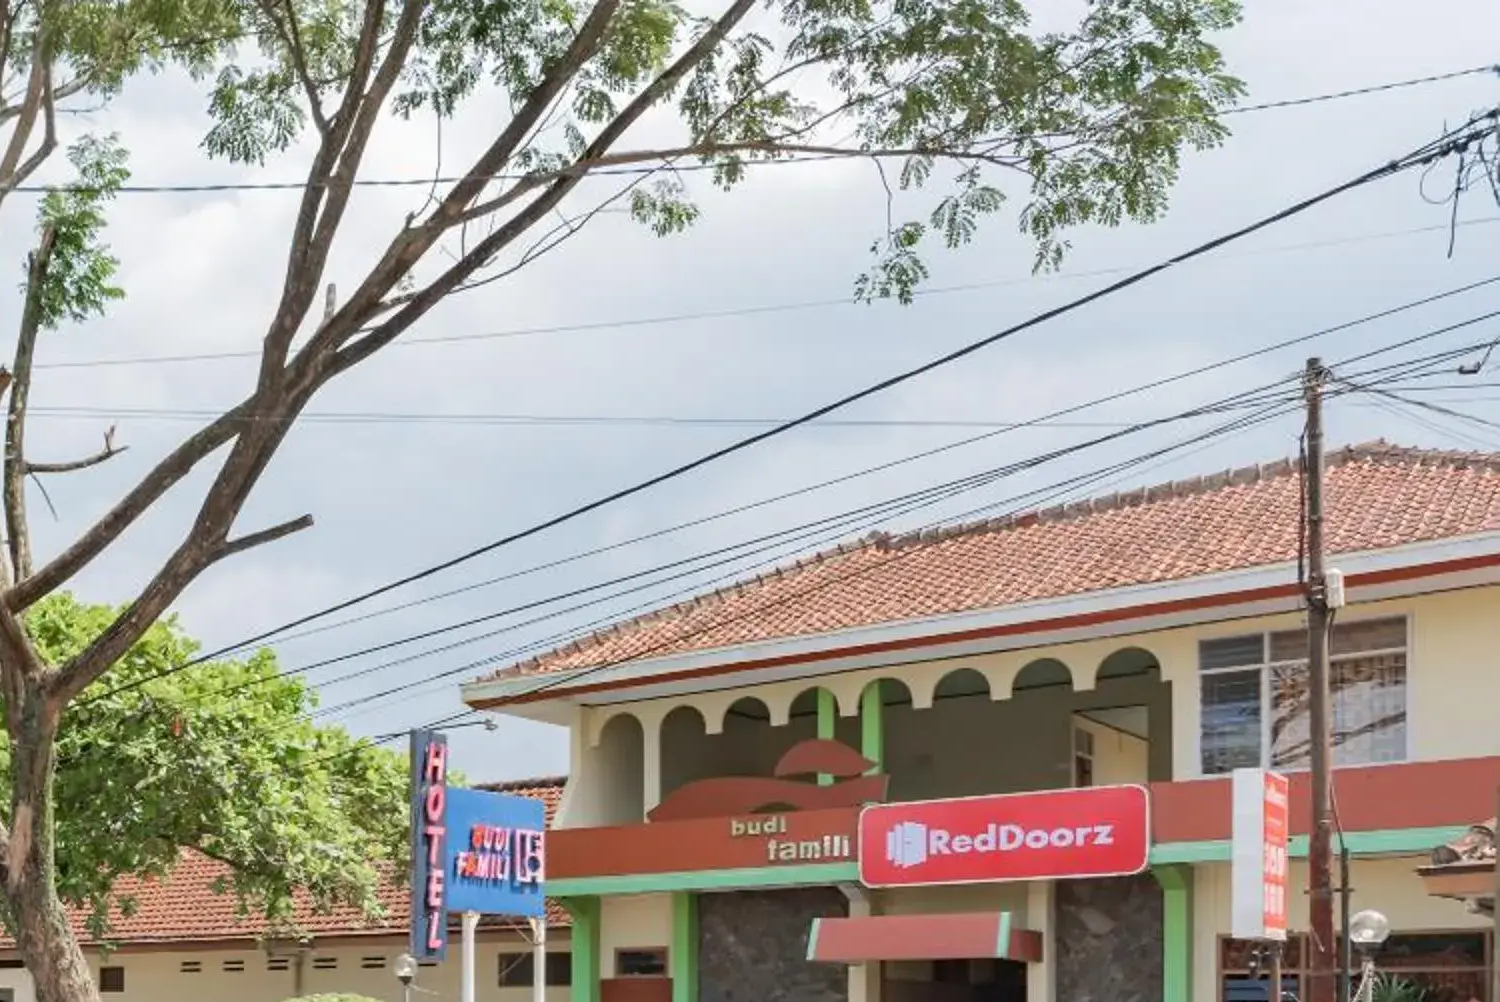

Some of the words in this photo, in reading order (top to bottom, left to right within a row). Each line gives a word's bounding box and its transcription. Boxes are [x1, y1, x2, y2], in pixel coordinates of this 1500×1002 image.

[424, 741, 446, 949] HOTEL
[768, 835, 849, 860] famili
[929, 823, 1114, 855] RedDoorz
